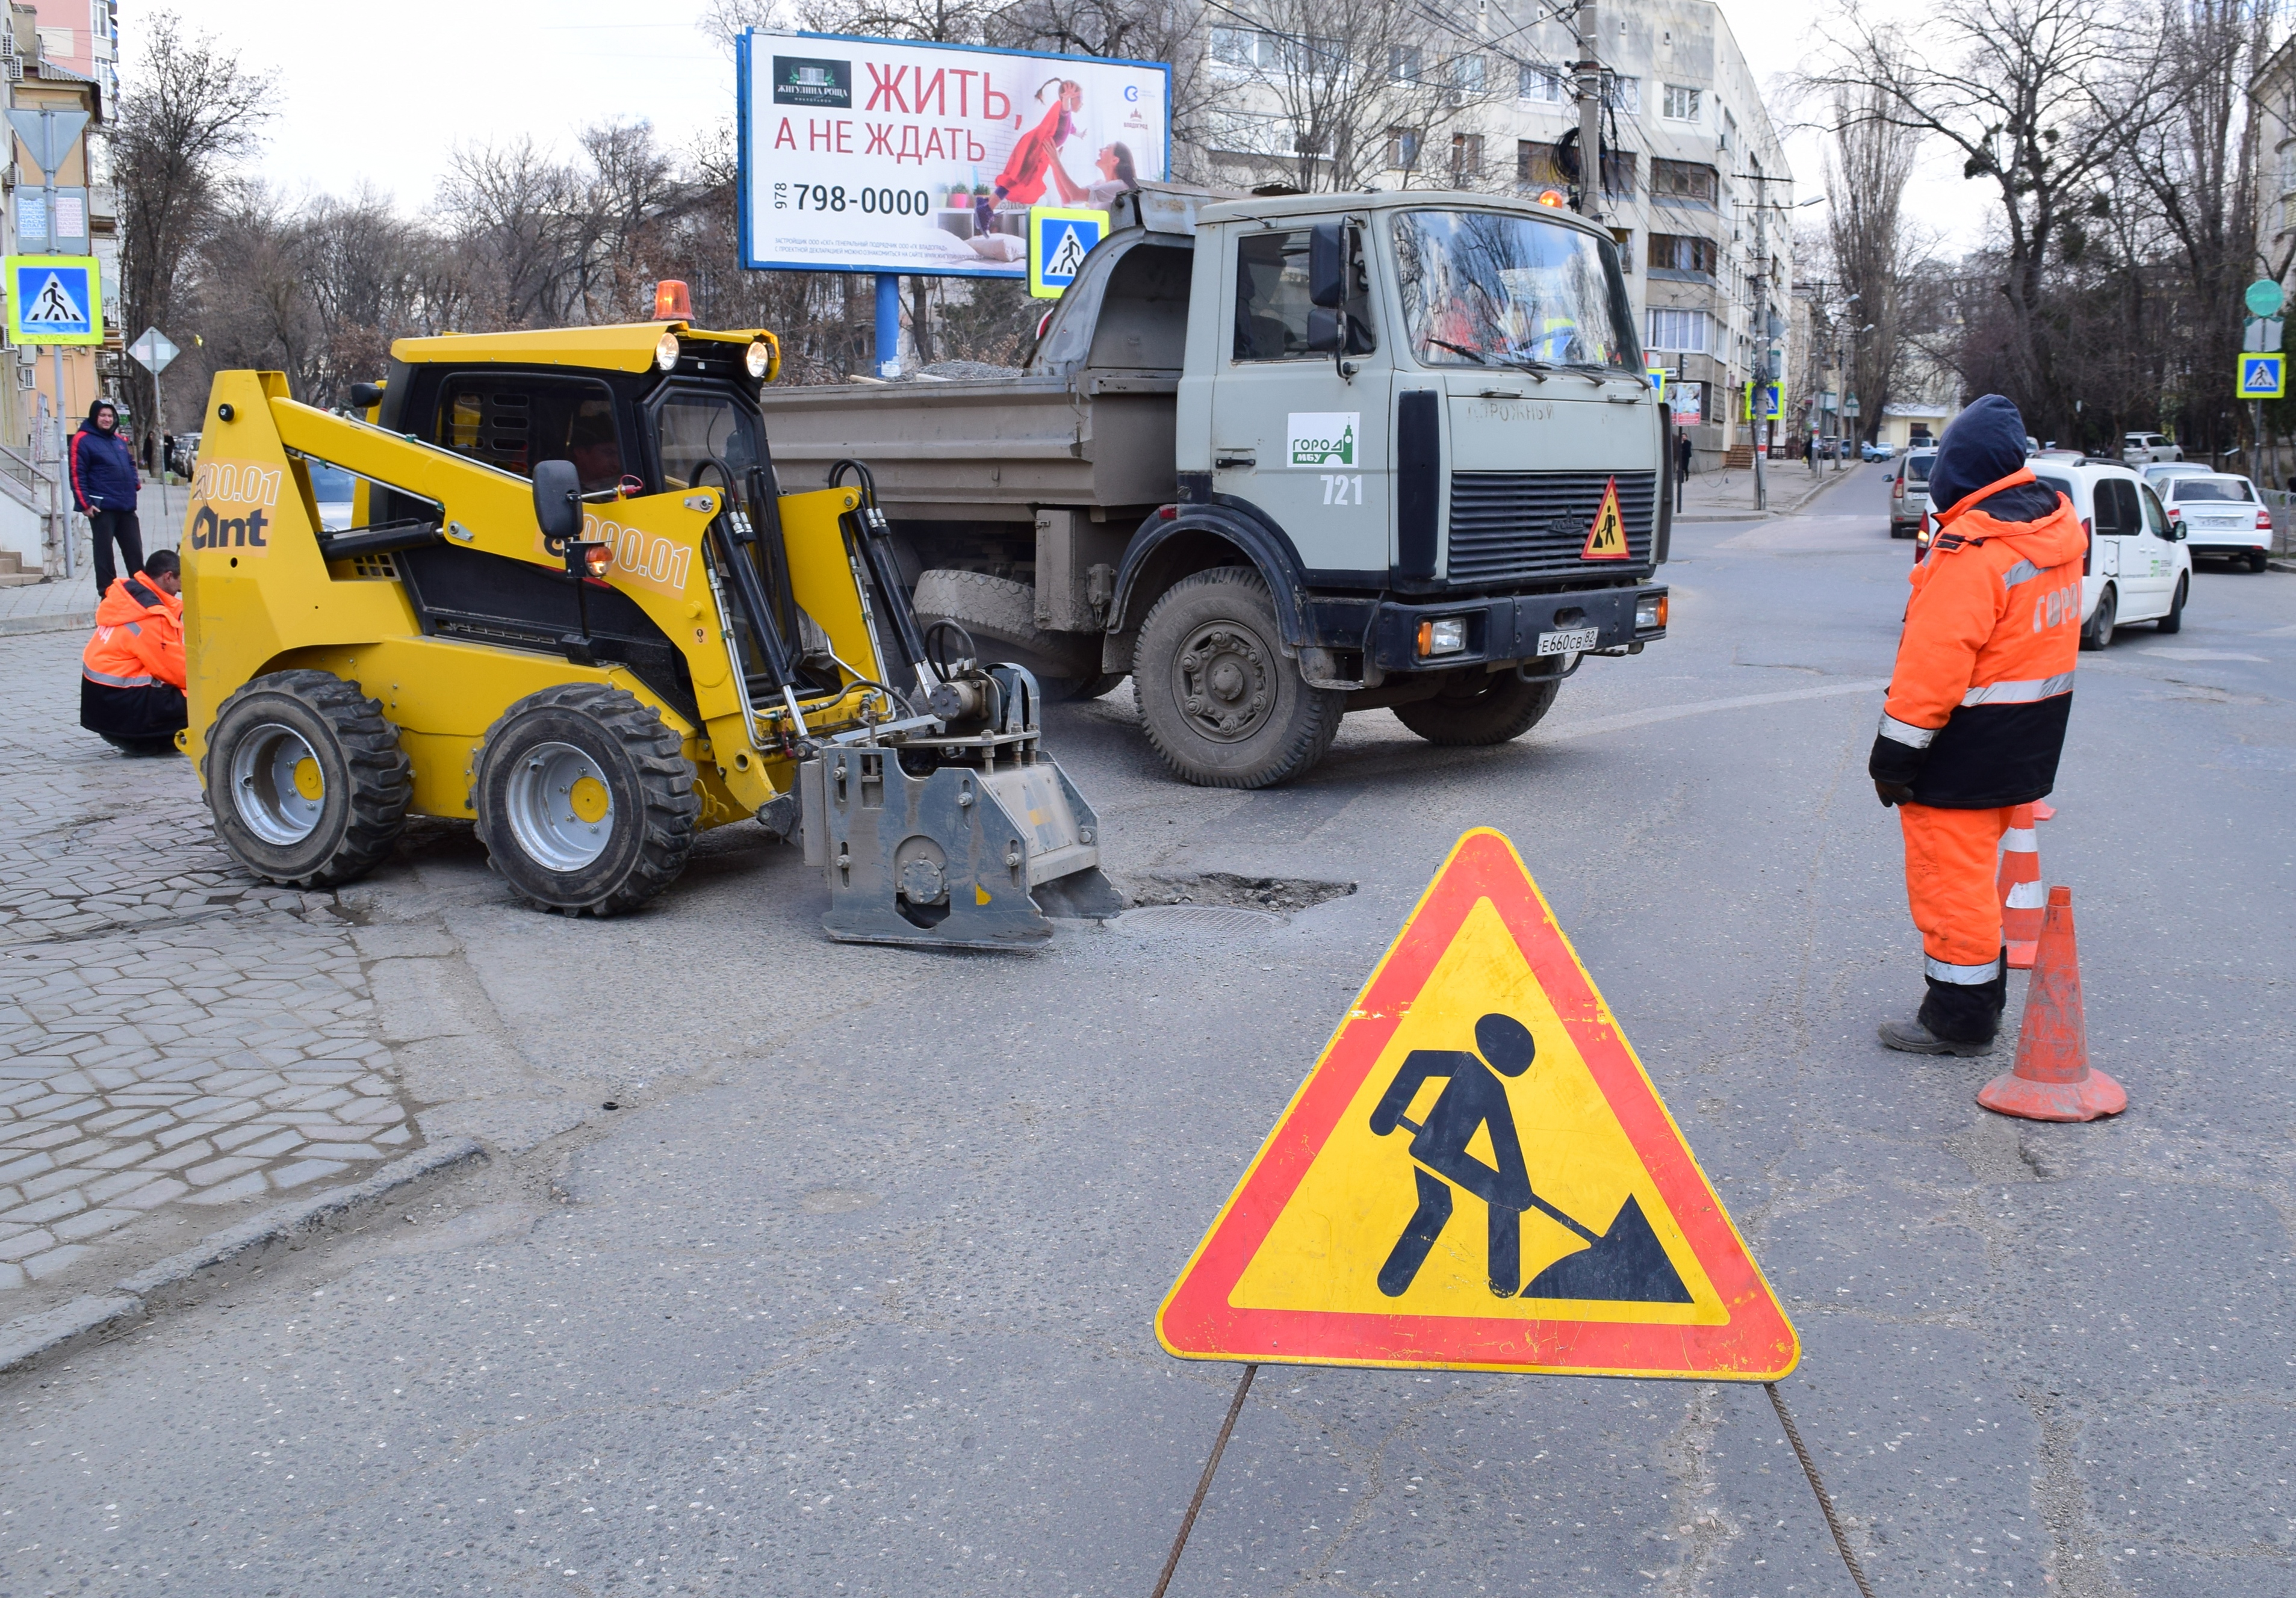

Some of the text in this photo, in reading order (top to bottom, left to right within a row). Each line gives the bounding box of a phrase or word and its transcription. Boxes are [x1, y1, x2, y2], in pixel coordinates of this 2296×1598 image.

[778, 84, 848, 98] ЖИГУЛИНА РОЩА
[864, 62, 1022, 130] ЖИТЬ,
[774, 117, 985, 166] А НЕ ЖДАТЬ
[774, 182, 787, 209] 978
[793, 183, 929, 216] 798-0000
[1467, 401, 1554, 422] РОЖНЫЙ
[1293, 439, 1342, 451] ГОРОД
[1296, 454, 1321, 463] МБУ
[1320, 474, 1362, 506] 721
[2033, 583, 2080, 633] ГОРО
[1584, 630, 1595, 643] 82
